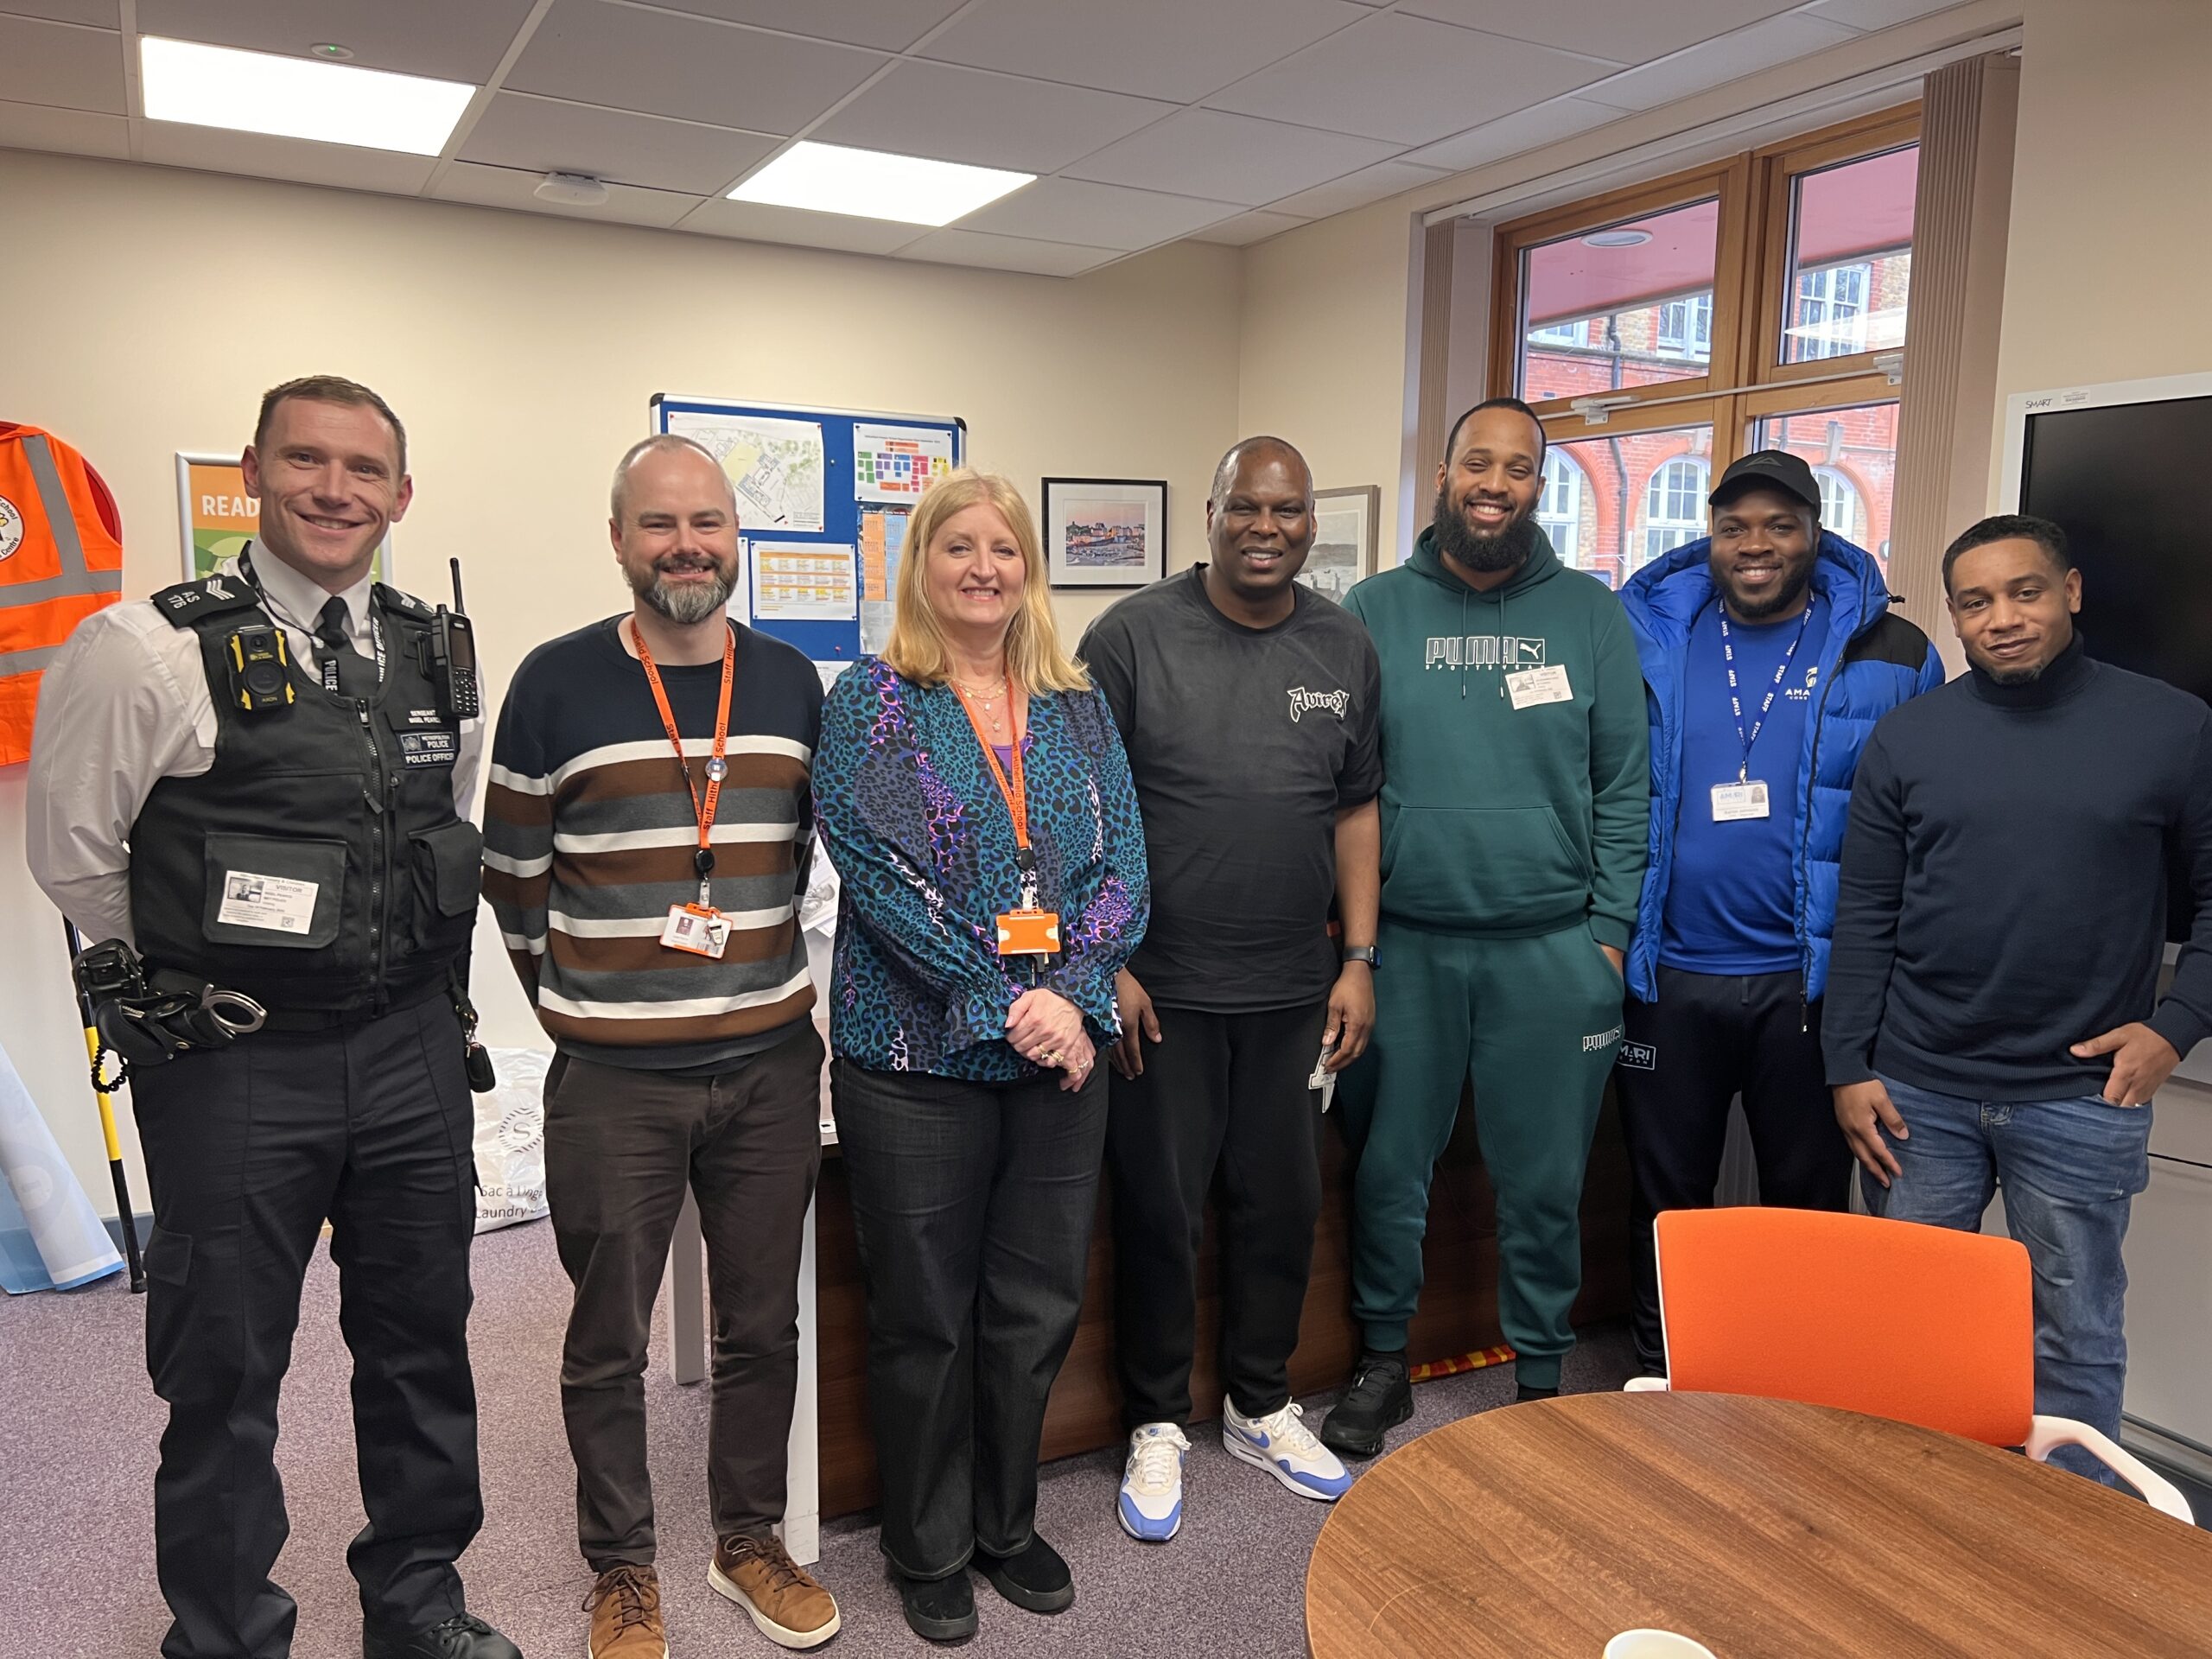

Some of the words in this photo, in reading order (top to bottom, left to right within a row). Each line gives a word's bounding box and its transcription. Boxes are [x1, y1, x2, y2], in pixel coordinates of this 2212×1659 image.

[2025, 398, 2053, 409] SMART
[0, 499, 18, 520] chool
[181, 591, 201, 603] AS
[1426, 636, 1516, 664] PUMA
[325, 659, 338, 691] POLICE
[716, 722, 727, 753] School
[405, 753, 432, 764] POLICE
[1016, 800, 1025, 830] School
[276, 884, 303, 893] VISITOR
